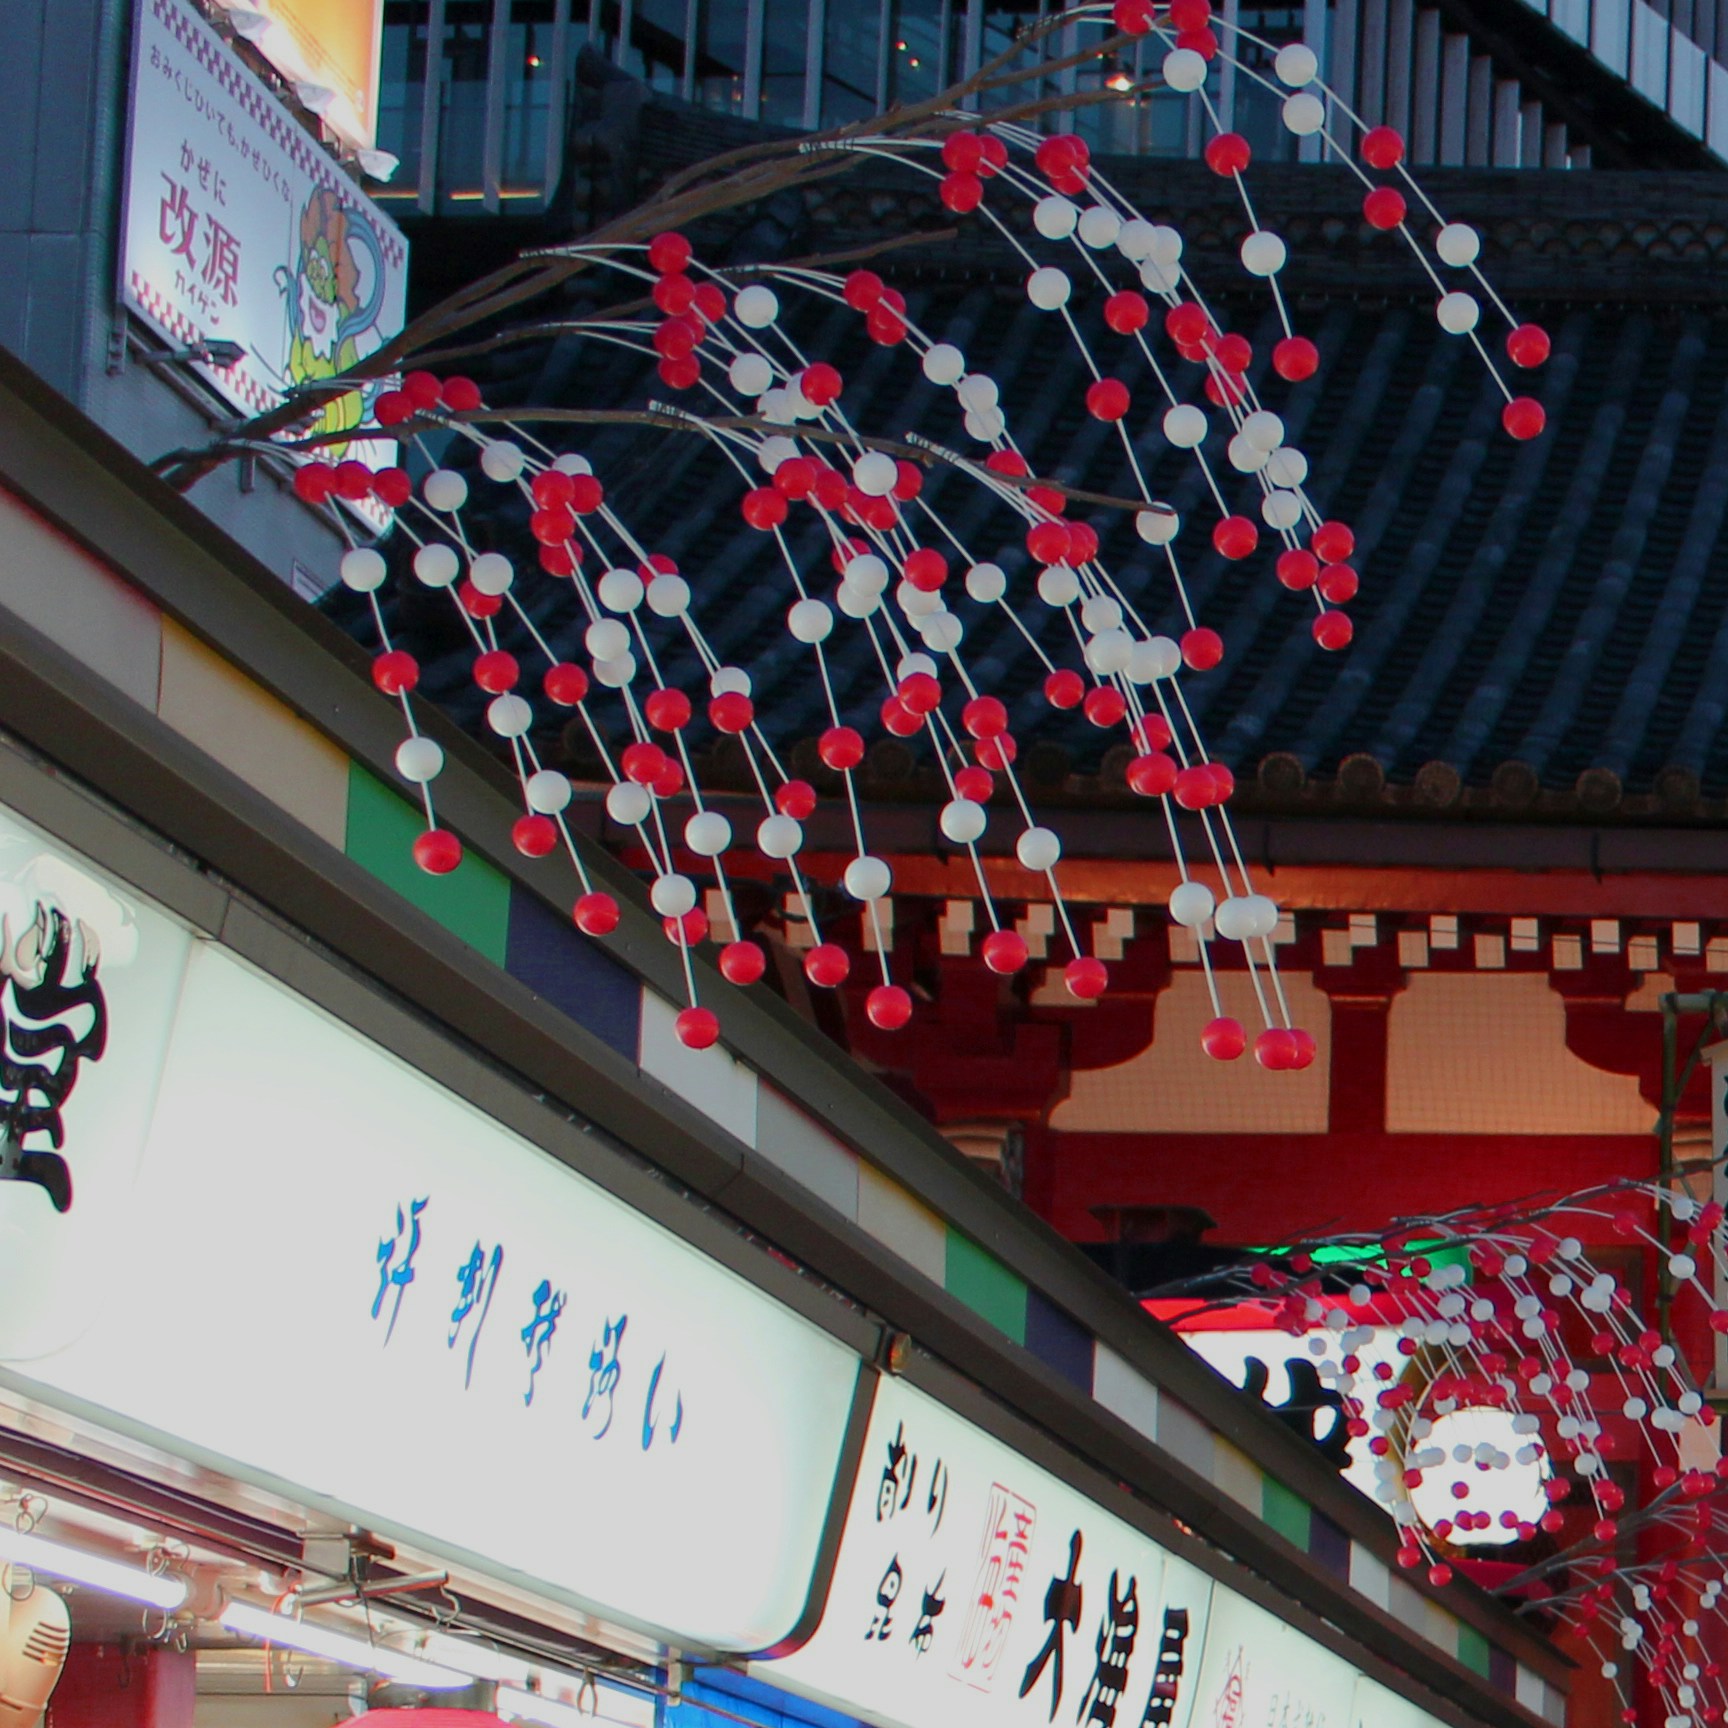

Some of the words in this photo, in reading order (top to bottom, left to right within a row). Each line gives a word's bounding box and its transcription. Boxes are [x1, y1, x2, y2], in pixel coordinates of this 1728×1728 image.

[181, 139, 227, 207] かぜに
[160, 171, 241, 307] 改源
[175, 268, 220, 325] カイゲン
[877, 1419, 948, 1539] 削り
[864, 1552, 947, 1661] 昆布
